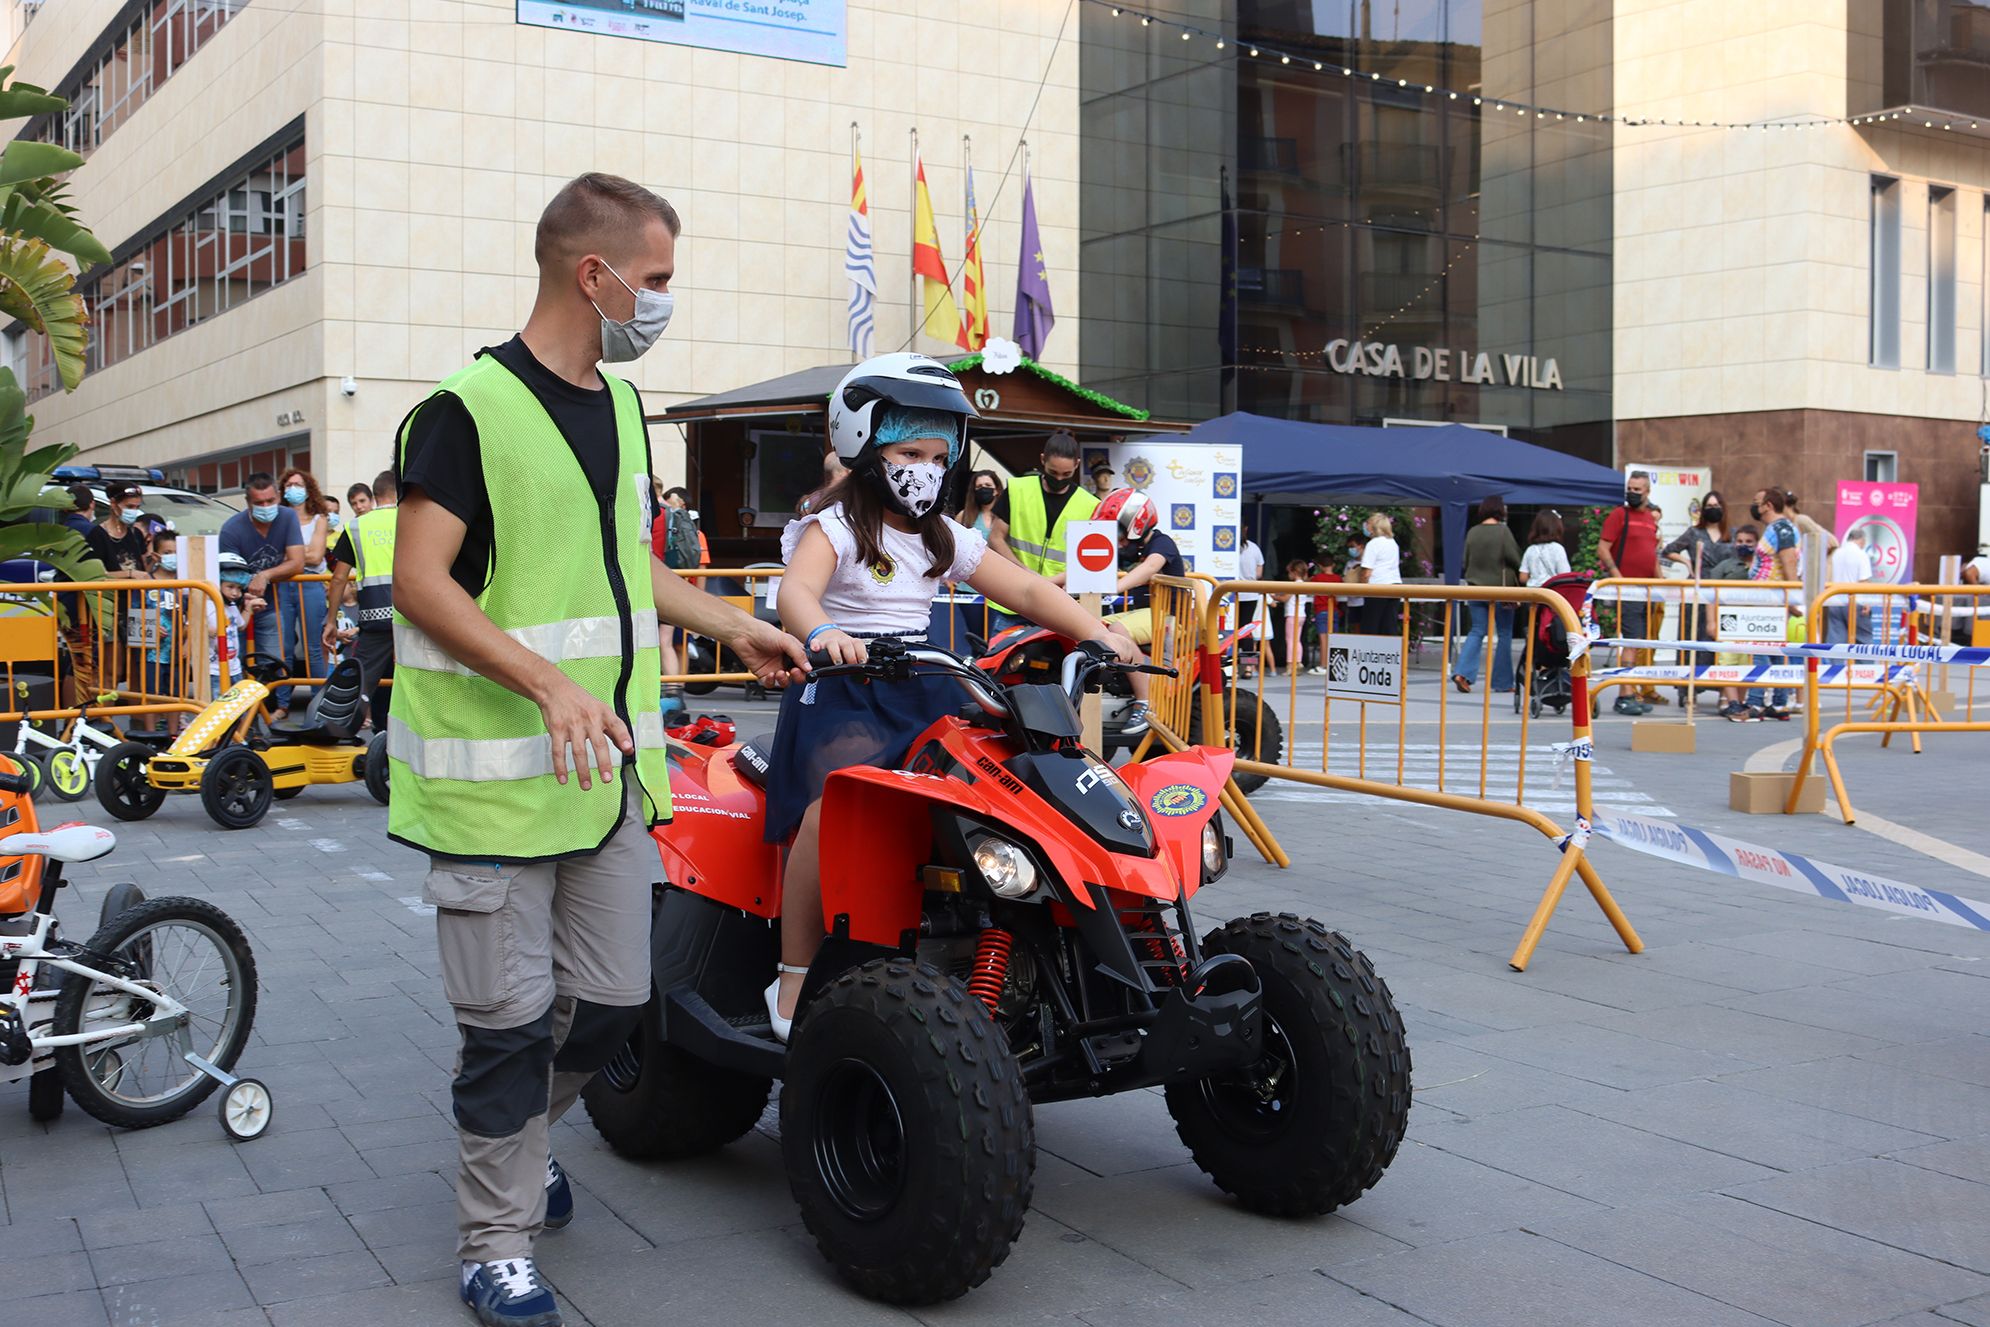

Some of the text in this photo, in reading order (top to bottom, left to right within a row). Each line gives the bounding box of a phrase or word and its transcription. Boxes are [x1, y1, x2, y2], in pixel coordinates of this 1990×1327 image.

[725, 0, 740, 12] de
[743, 1, 769, 15] Sant
[771, 5, 808, 22] Josep.
[1325, 338, 1564, 390] CASA DE LA VILA
[1741, 613, 1785, 624] Ajuntament
[1747, 623, 1777, 633] Onda
[1352, 648, 1400, 666] Ajuntament
[1359, 665, 1391, 686] Onda
[1718, 670, 1739, 679] PASAR
[1769, 669, 1794, 679] POLICIA
[1855, 670, 1875, 679] PASAR
[740, 745, 769, 774] can-am
[976, 756, 1024, 795] can-am
[678, 793, 710, 801] LOCAL
[672, 805, 751, 820] EDUCACION VIAL
